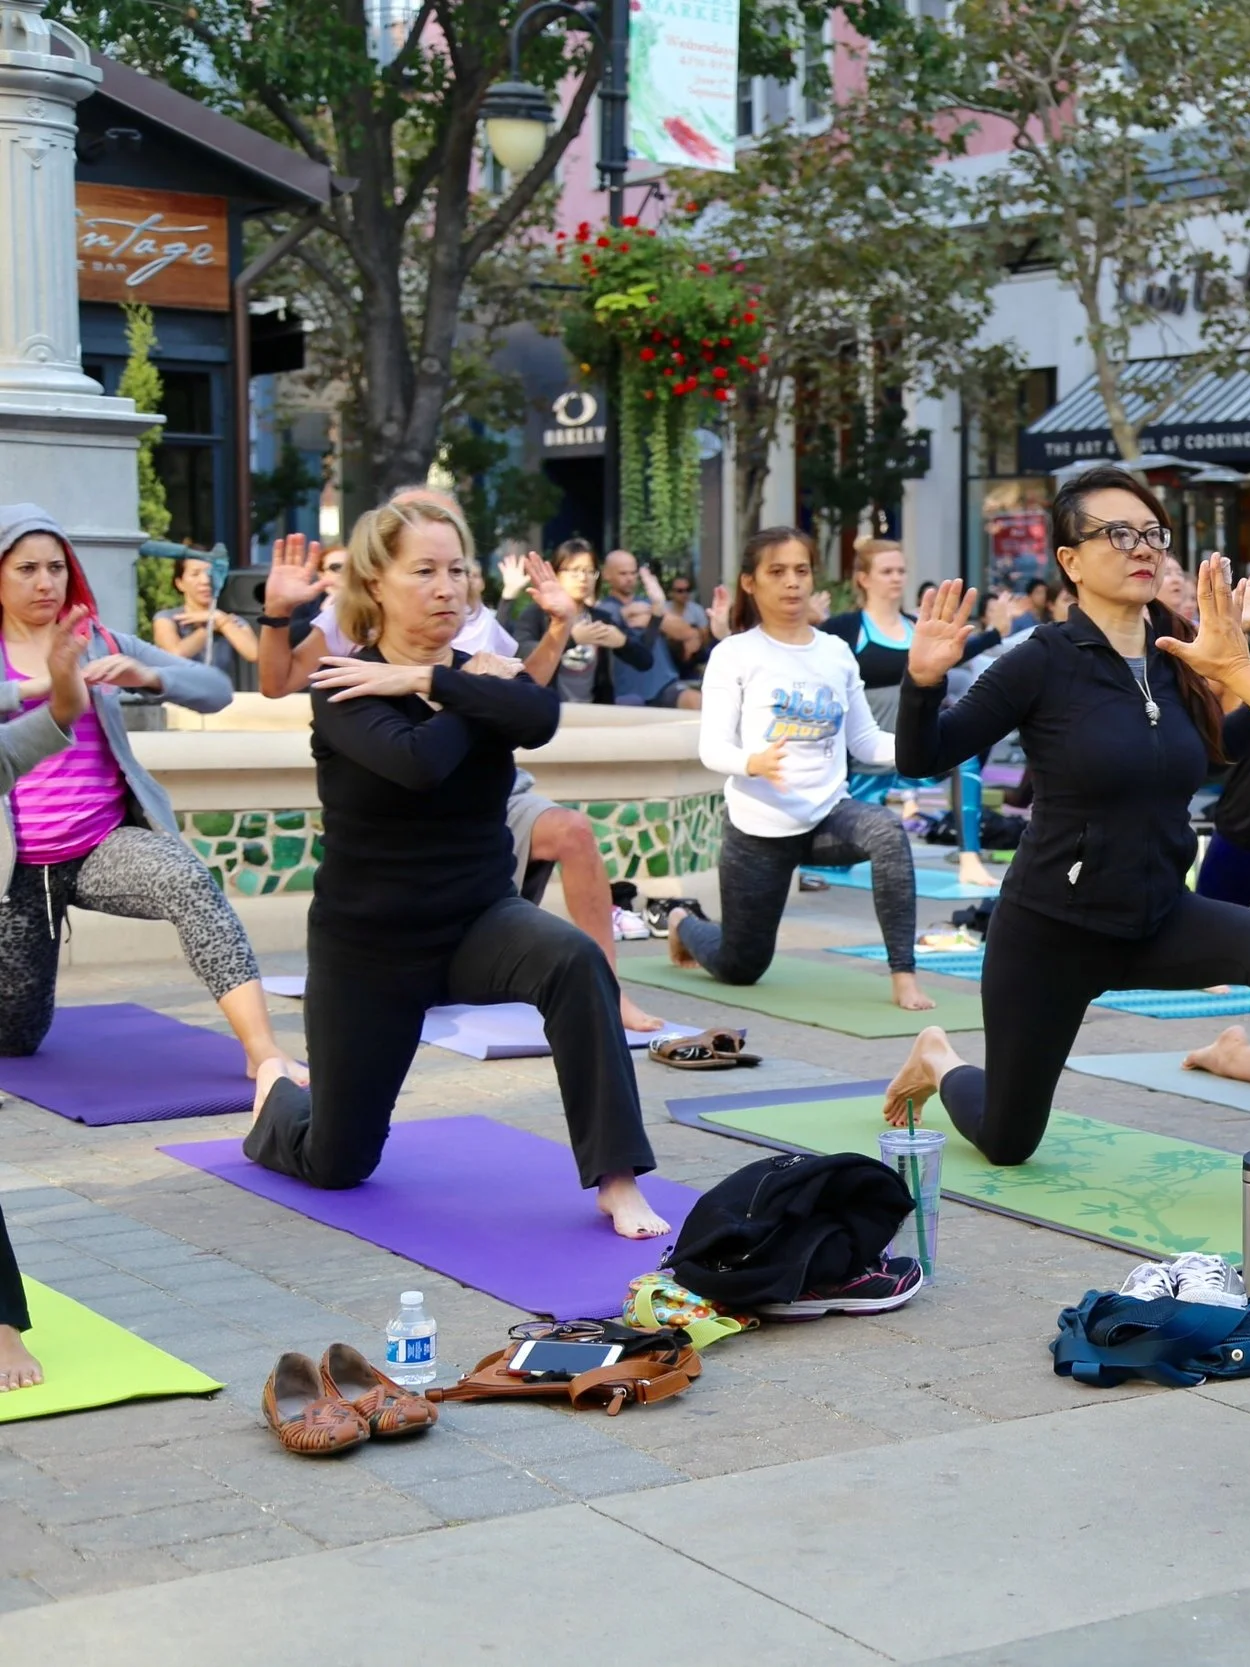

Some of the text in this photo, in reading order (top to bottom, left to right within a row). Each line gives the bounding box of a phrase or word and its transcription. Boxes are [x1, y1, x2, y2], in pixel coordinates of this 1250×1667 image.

[73, 207, 216, 287] ntage
[1045, 441, 1071, 457] THE
[1075, 440, 1103, 456] ART
[1161, 434, 1182, 451] OF
